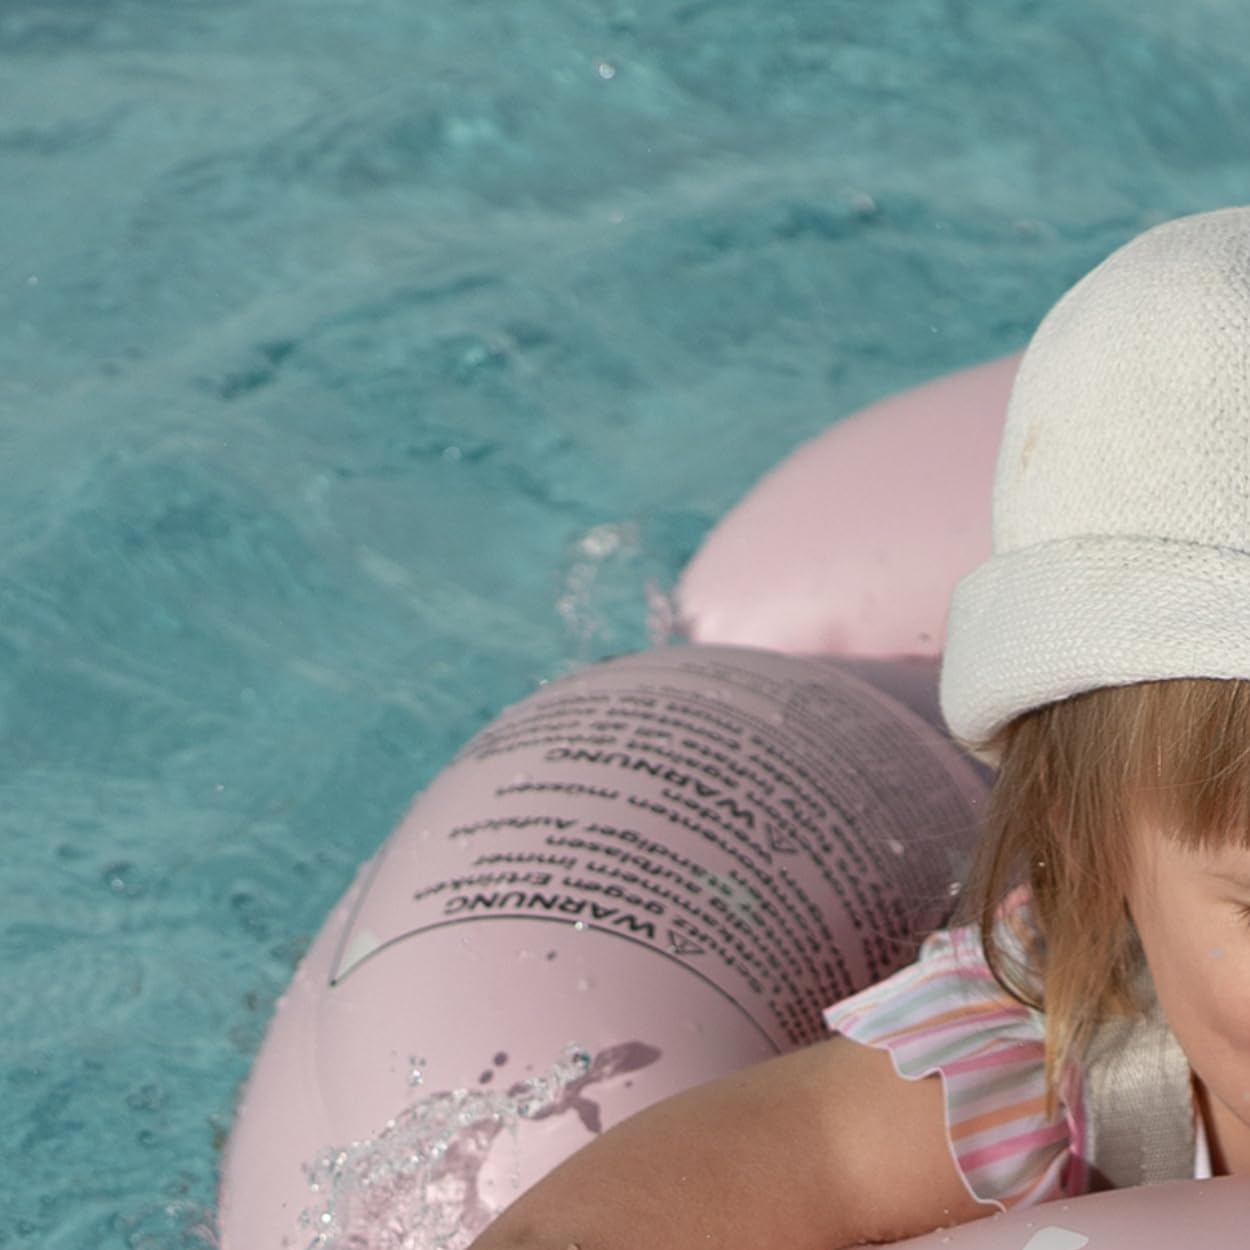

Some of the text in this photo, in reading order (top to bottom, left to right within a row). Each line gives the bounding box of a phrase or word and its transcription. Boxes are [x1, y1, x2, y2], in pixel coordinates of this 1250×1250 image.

[448, 818, 577, 838] Aufsicht
[472, 852, 576, 870] immer
[545, 838, 700, 892] aufblasen
[584, 825, 731, 896] ständiger
[412, 872, 551, 902] Ertrinken
[563, 876, 664, 915] gegen
[443, 891, 653, 939] WARNUNG
